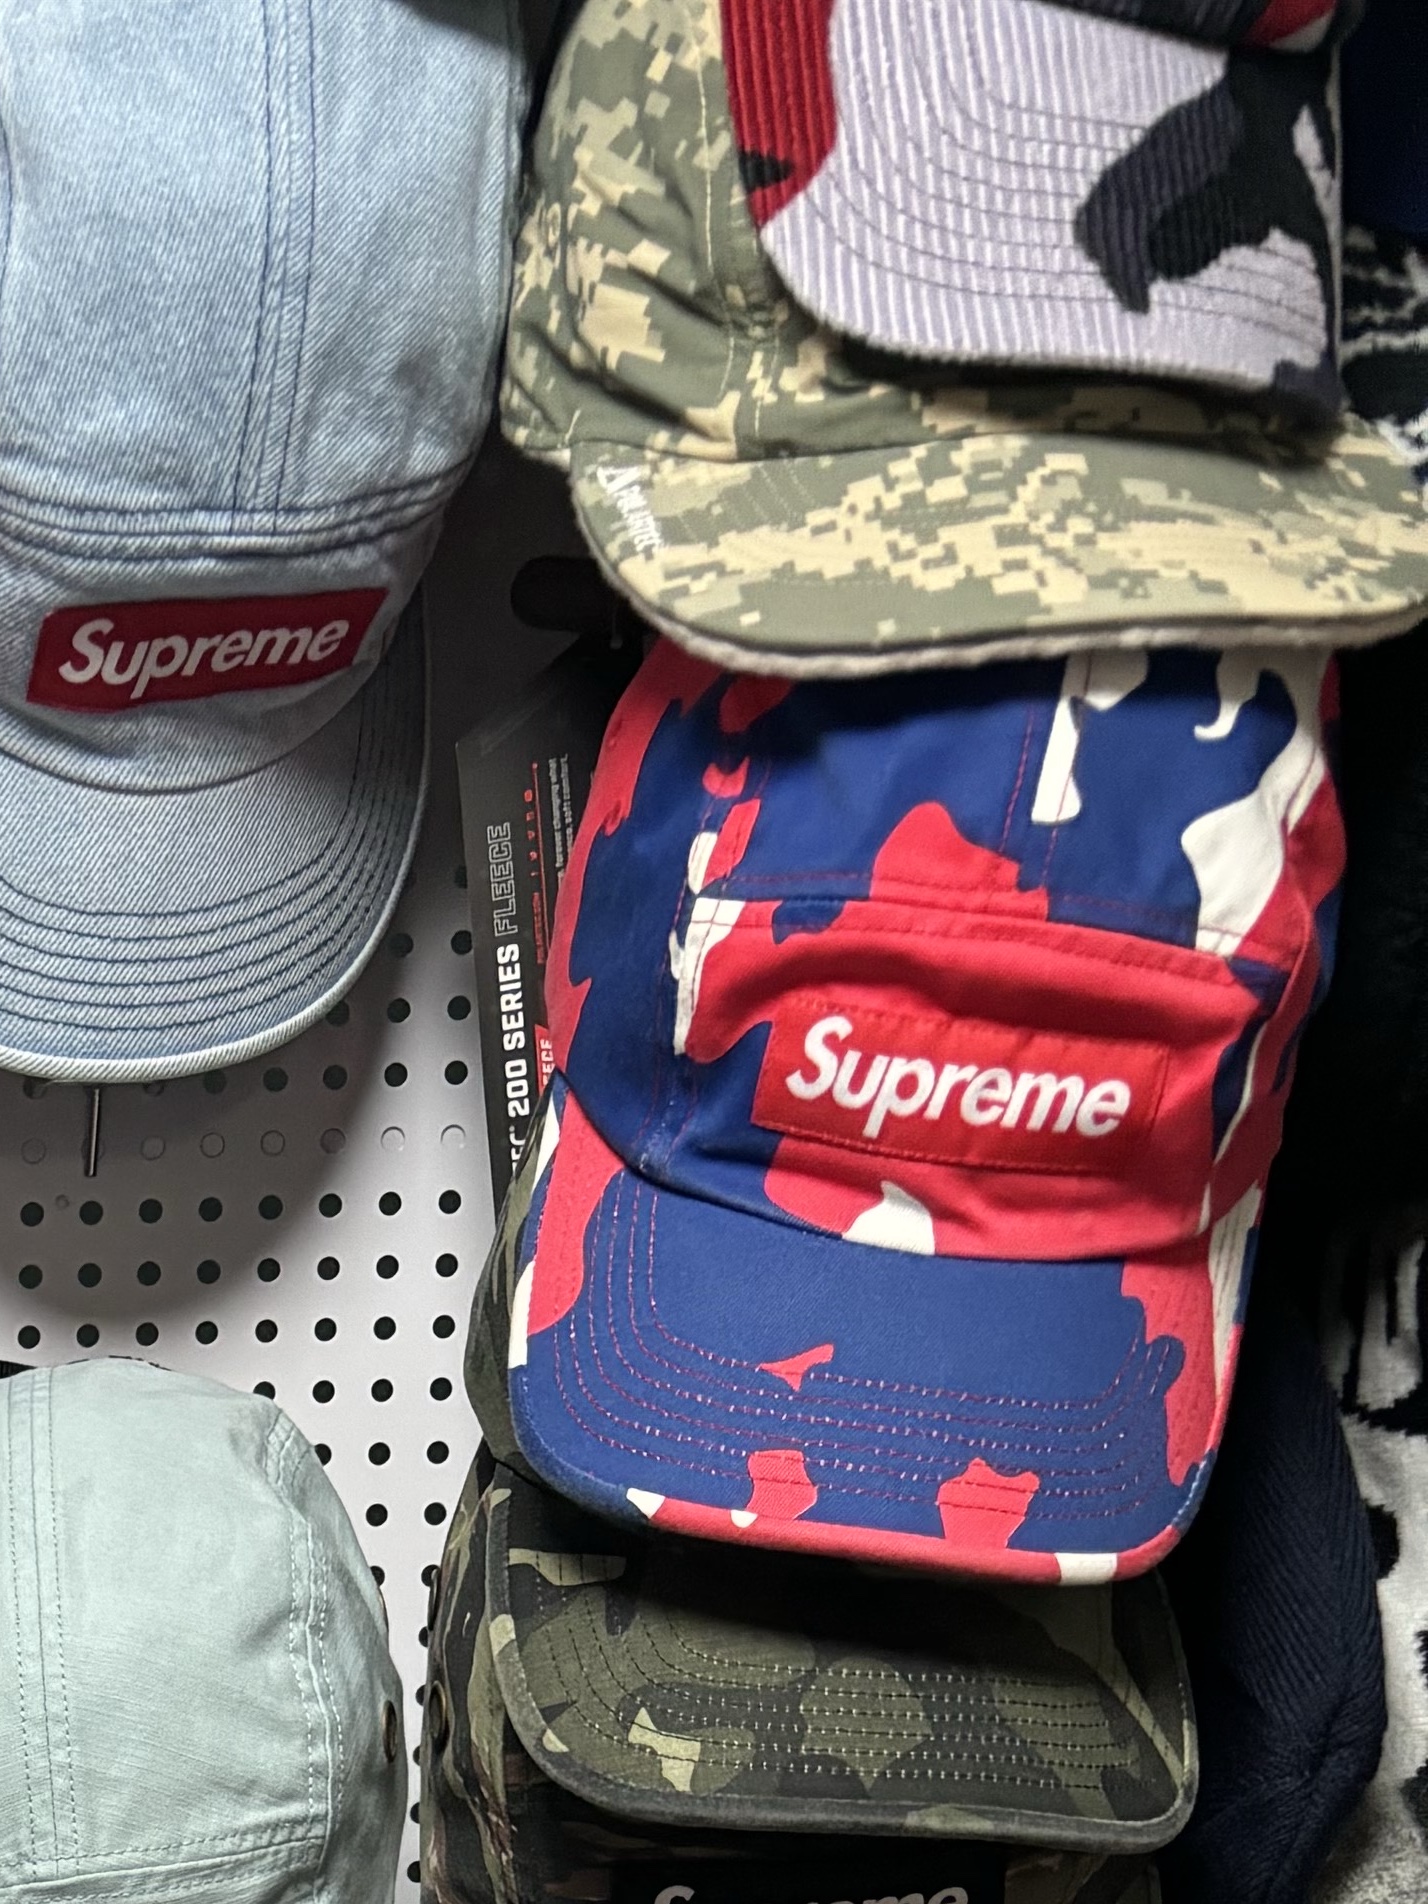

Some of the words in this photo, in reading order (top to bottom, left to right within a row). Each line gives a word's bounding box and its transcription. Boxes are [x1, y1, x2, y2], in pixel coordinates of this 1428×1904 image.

[59, 619, 349, 699] Supreme
[487, 822, 519, 937] FLEECE
[497, 943, 527, 1050] SERIES
[505, 1060, 531, 1117] 200
[786, 1015, 1130, 1137] Supreme
